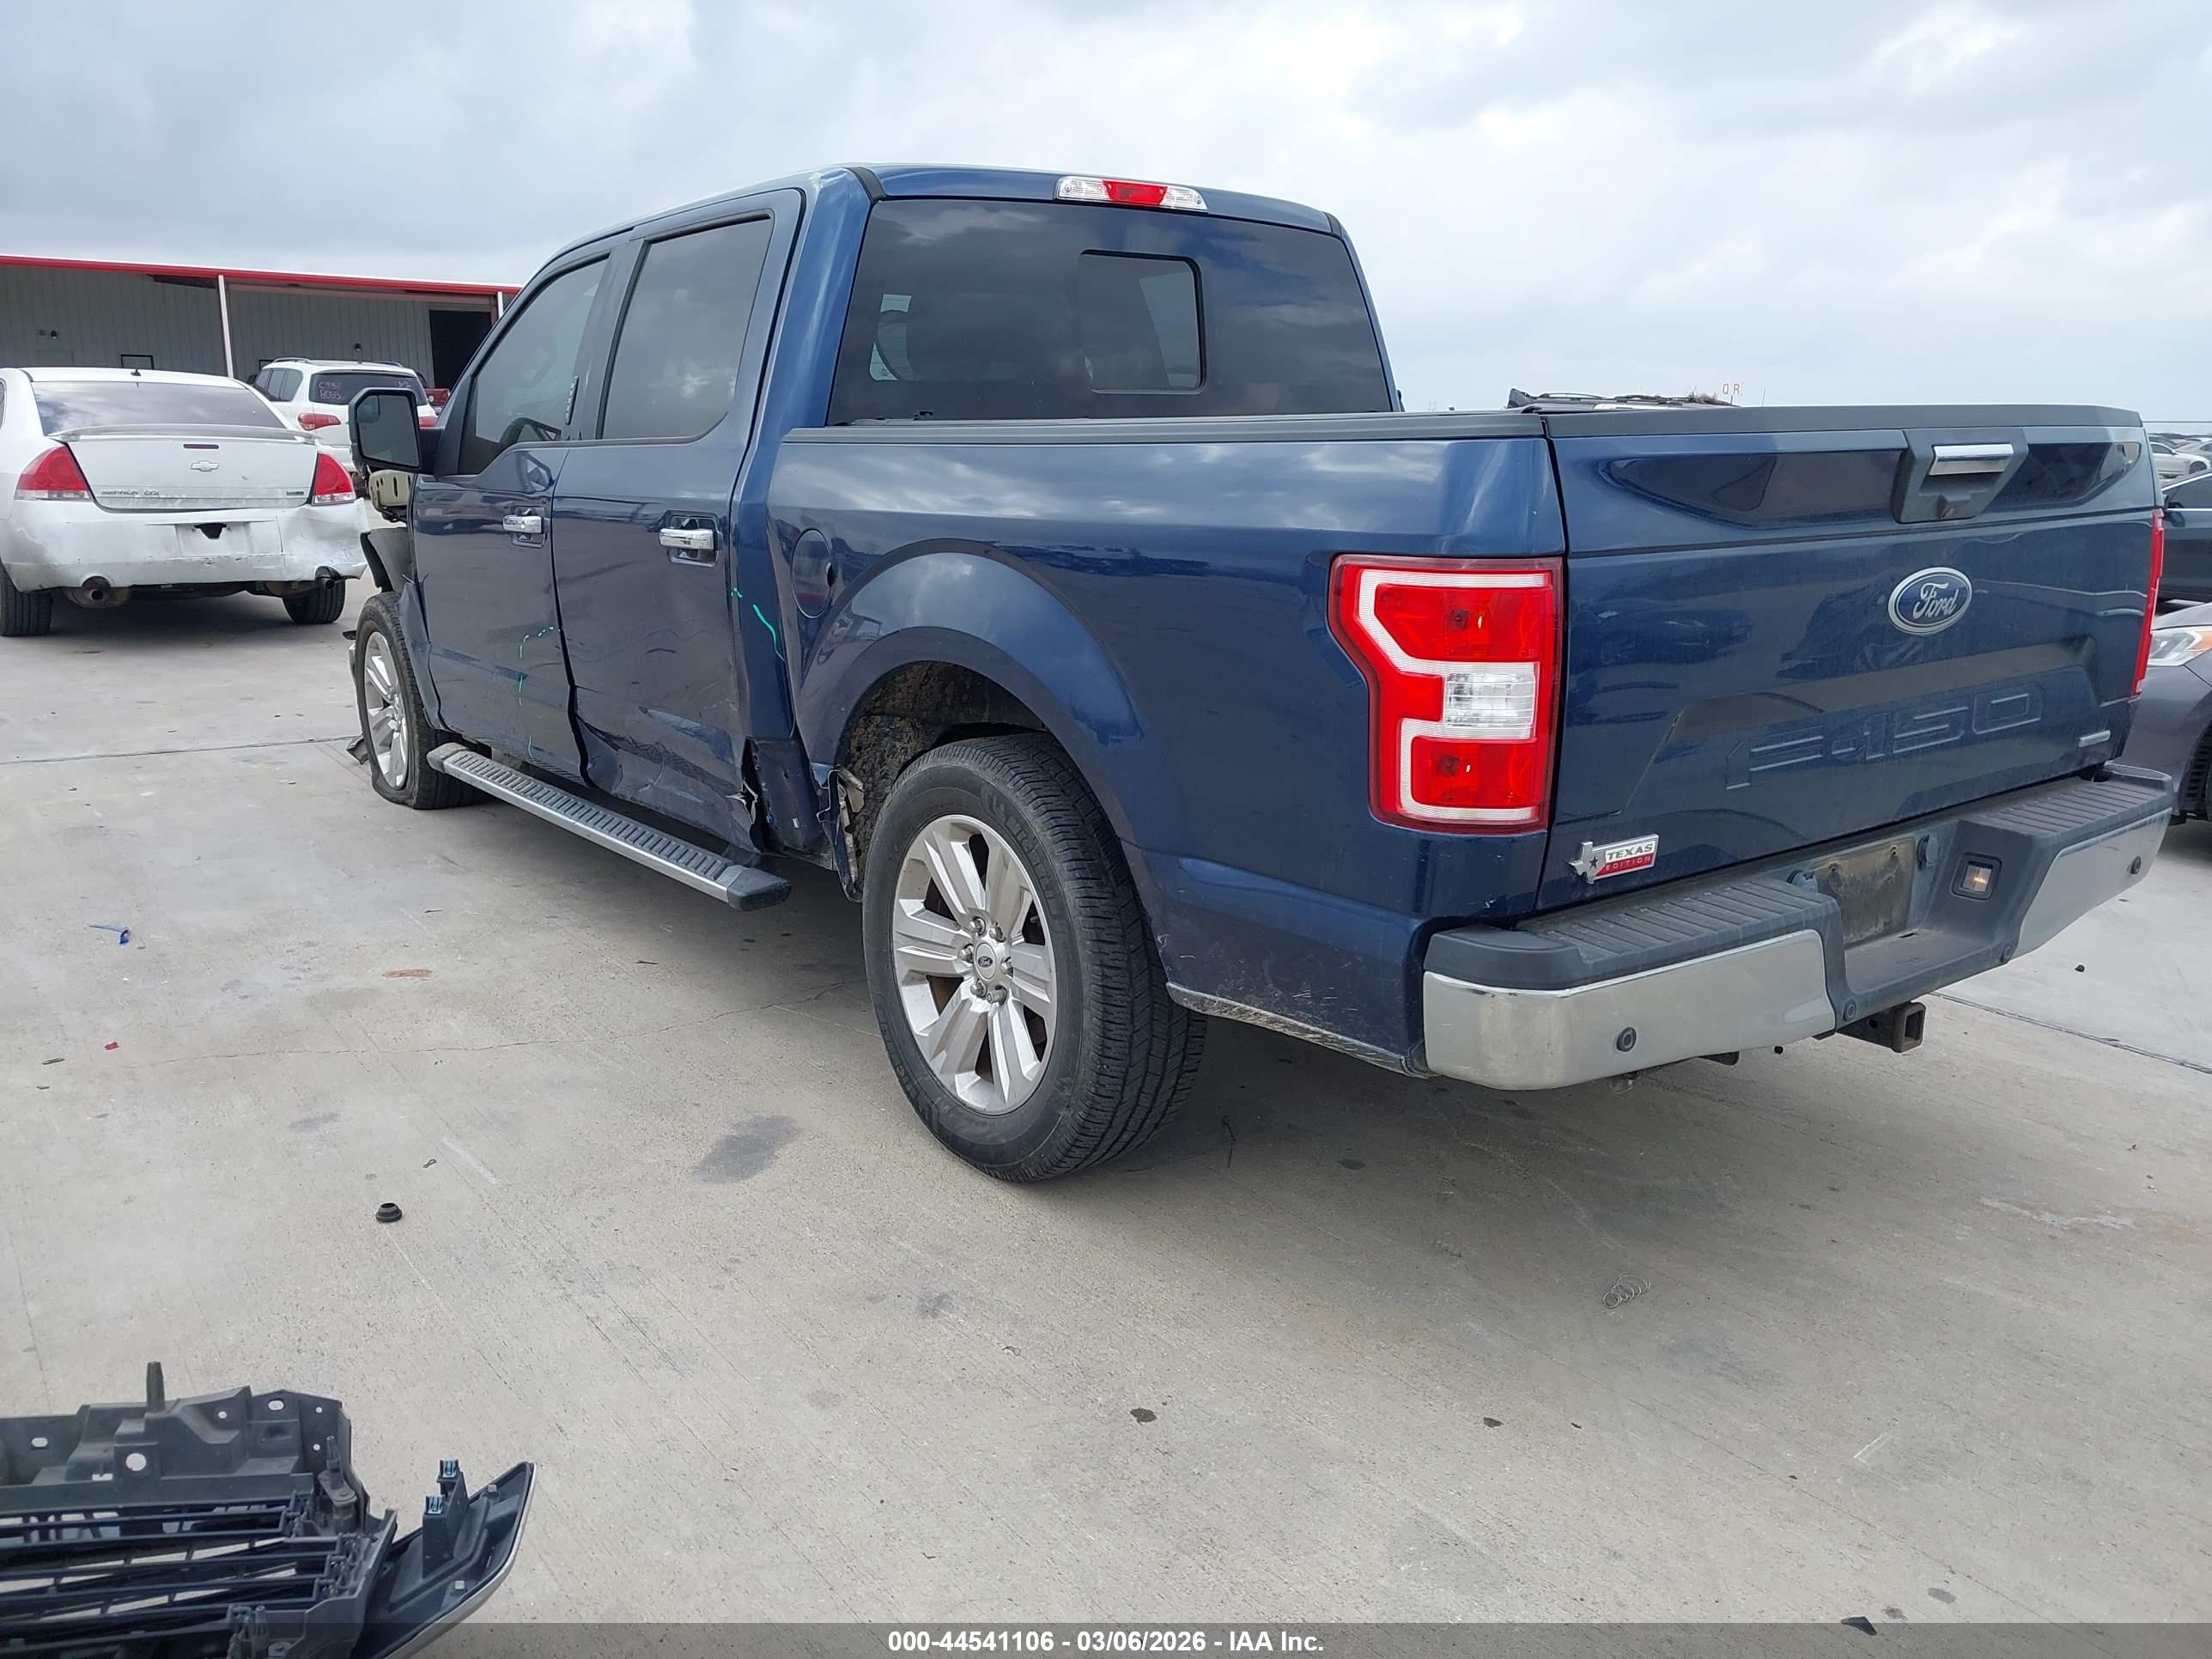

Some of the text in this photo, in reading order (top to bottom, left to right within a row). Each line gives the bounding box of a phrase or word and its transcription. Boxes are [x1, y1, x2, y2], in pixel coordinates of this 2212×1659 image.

[1912, 581, 1960, 619] Ford
[1725, 683, 2042, 790] F-150
[1605, 855, 1651, 871] EDITION
[1607, 843, 1653, 860] TEXAS
